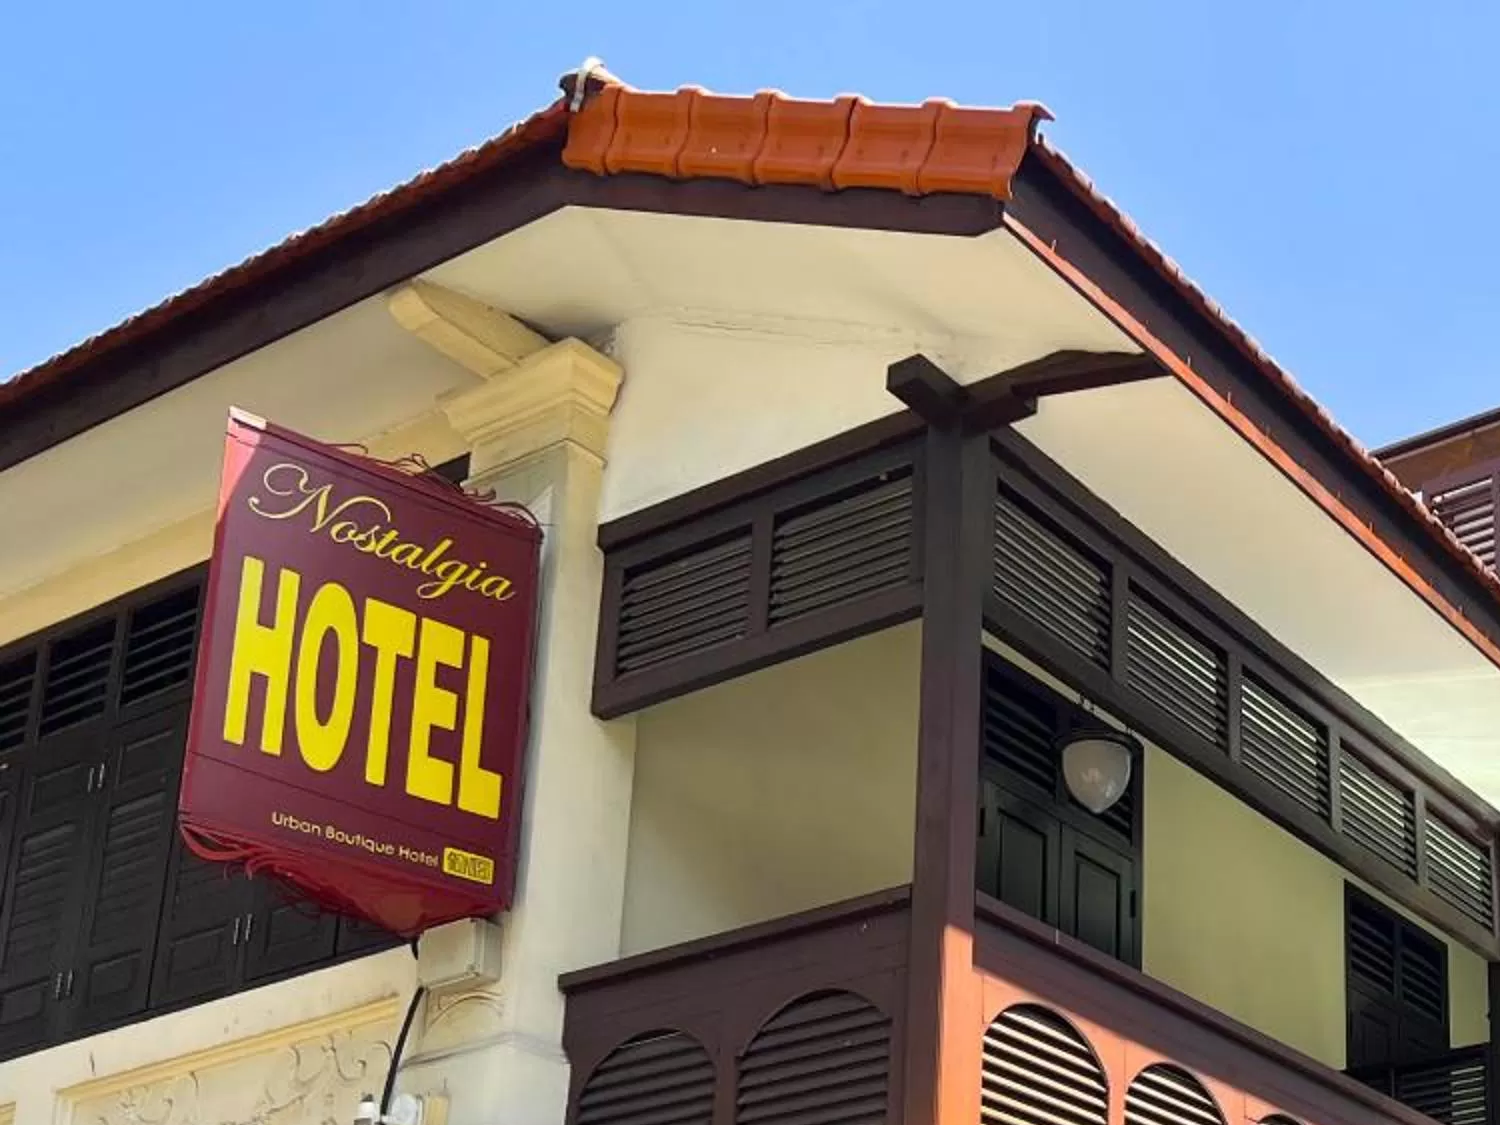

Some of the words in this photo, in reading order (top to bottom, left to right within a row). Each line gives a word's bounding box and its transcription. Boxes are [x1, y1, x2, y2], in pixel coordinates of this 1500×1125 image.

[247, 462, 515, 602] Nostalgia
[223, 555, 502, 820] HOTEL
[271, 811, 321, 837] Urban
[325, 825, 395, 856] Boutique
[398, 845, 440, 868] Hotel
